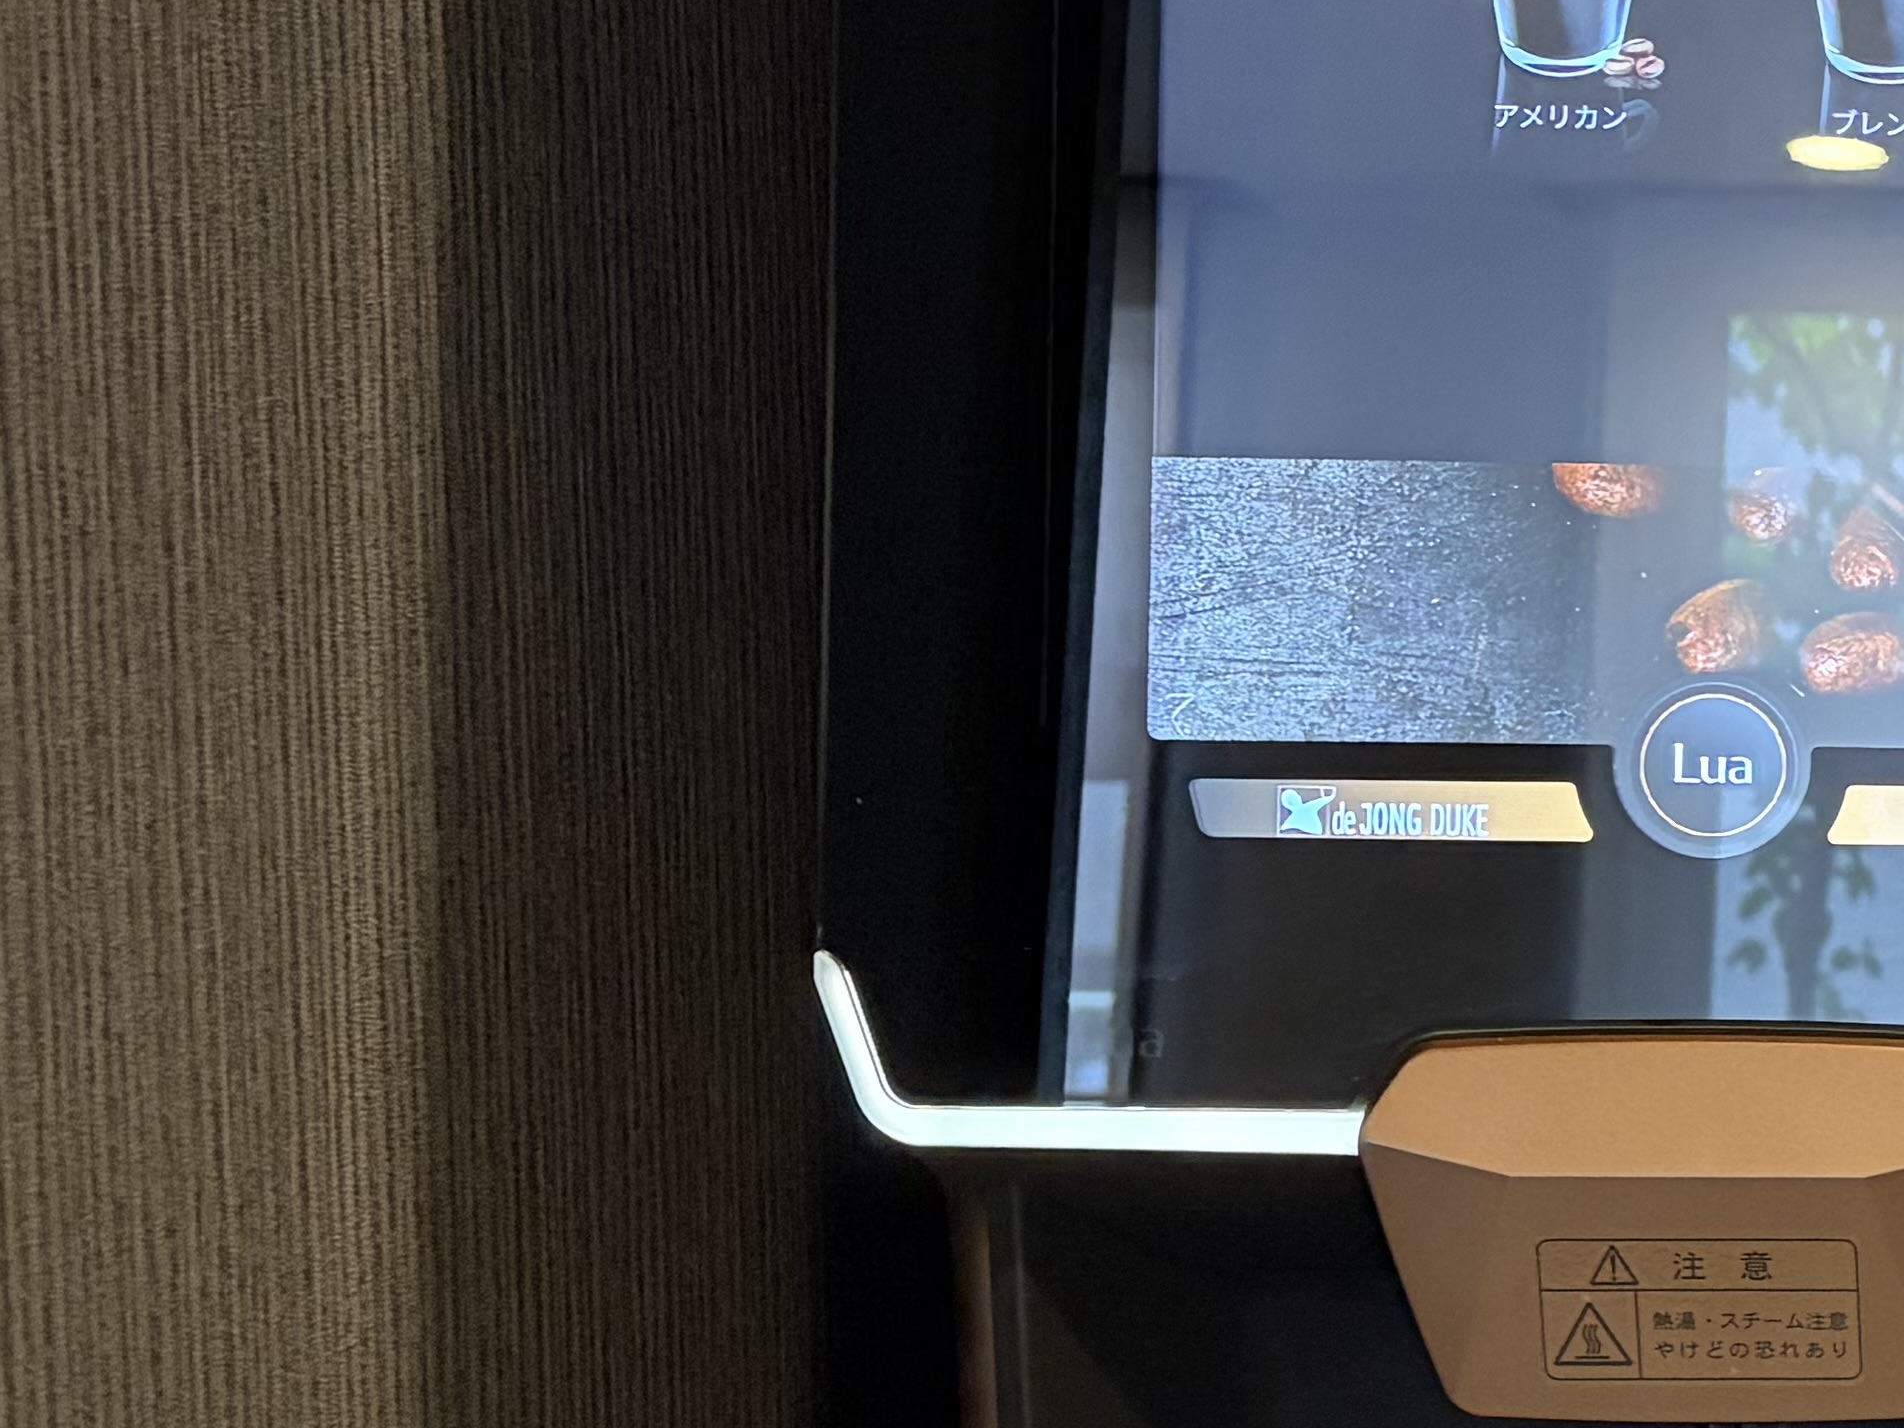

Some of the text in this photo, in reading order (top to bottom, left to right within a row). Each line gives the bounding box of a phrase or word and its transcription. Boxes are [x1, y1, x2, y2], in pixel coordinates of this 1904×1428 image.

[1493, 103, 1628, 132] アメリカン
[1673, 741, 1754, 786] Lua
[1332, 800, 1489, 838] de JONG DUKE
[1653, 1340, 1848, 1360] やけどの恐れあり
